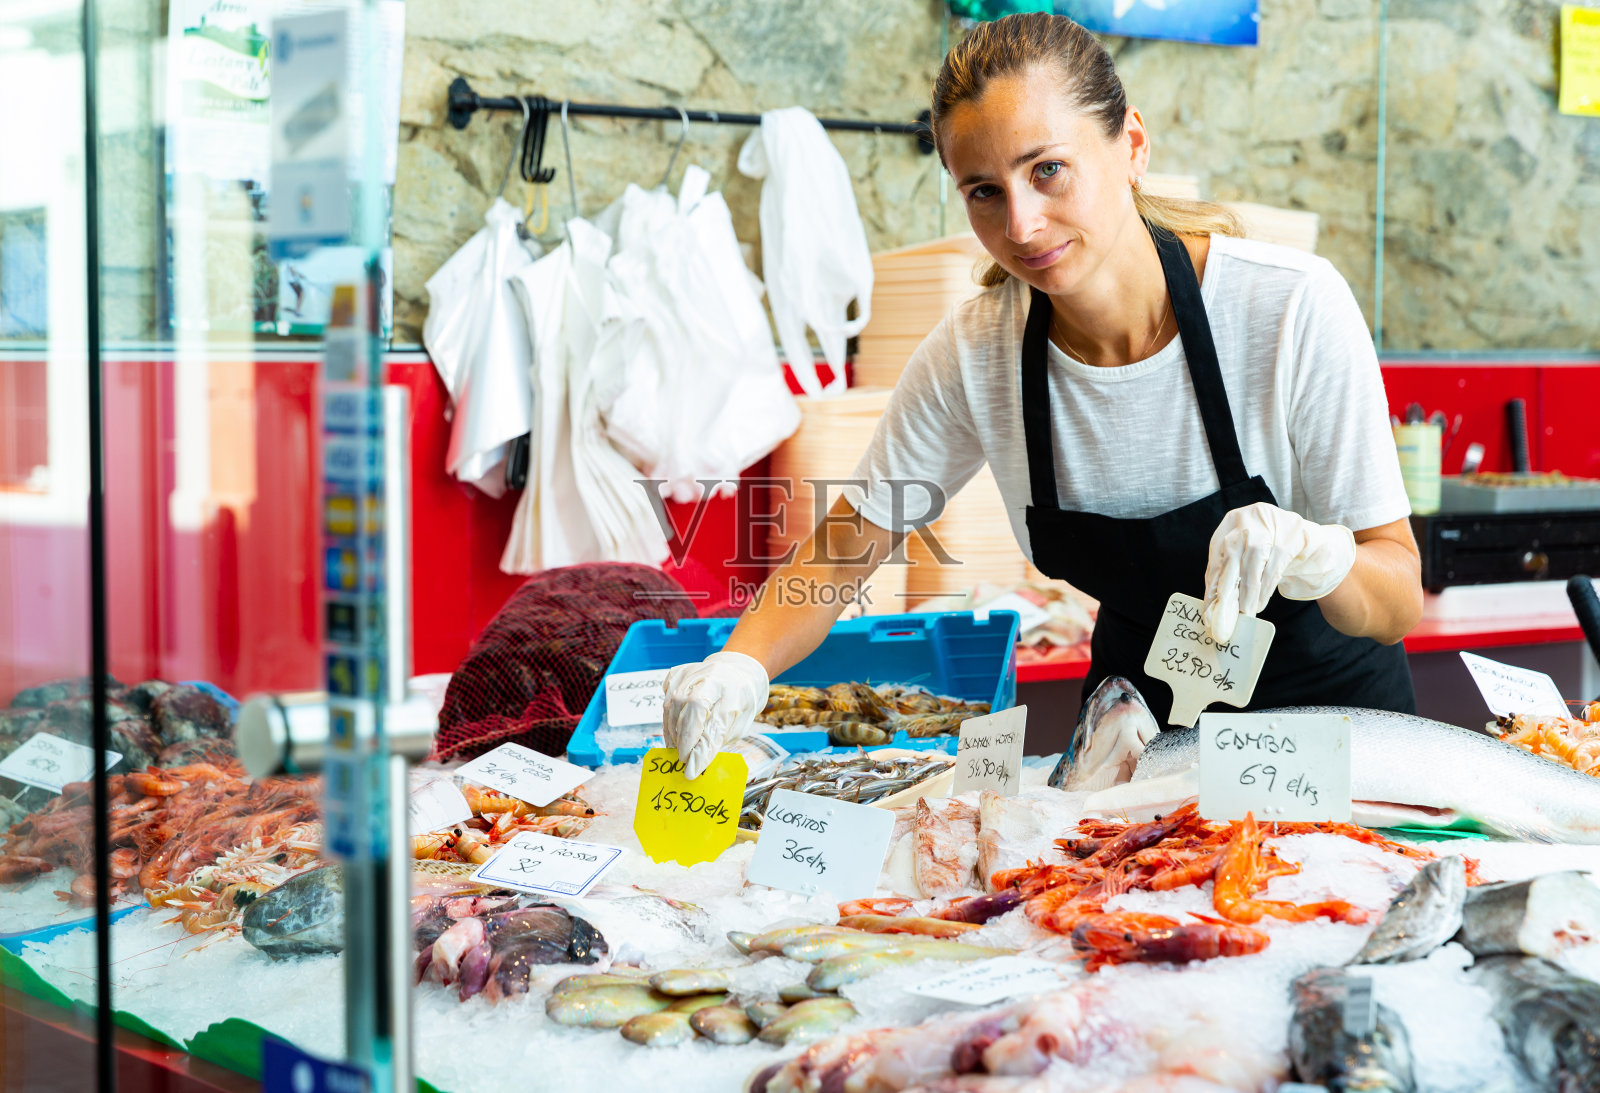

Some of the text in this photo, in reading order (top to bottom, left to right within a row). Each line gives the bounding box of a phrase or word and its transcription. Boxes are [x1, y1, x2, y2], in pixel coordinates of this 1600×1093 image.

[1215, 728, 1297, 753] GAMBA
[1240, 763, 1278, 792] 69
[782, 838, 814, 863] 36
